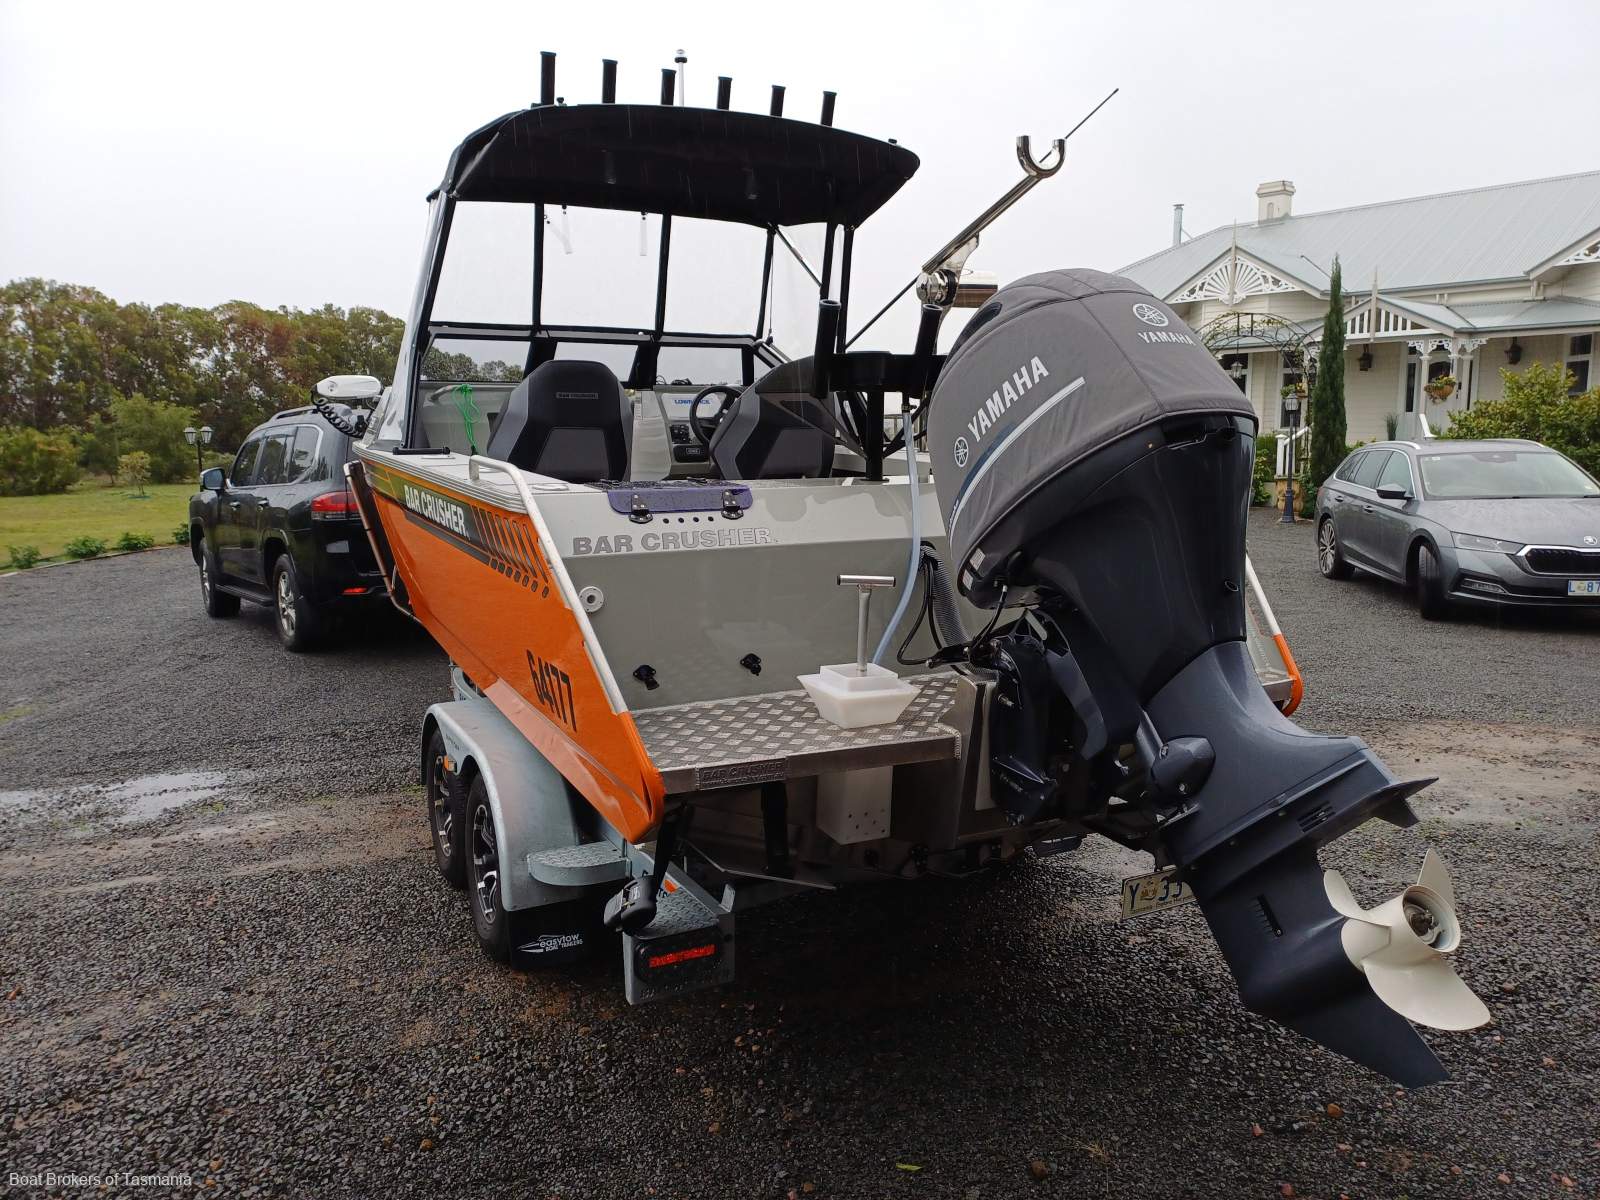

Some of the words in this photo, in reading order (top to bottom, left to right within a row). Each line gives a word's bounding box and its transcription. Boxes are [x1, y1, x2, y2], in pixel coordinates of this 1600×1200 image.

[1137, 331, 1197, 346] YAMAHA
[967, 355, 1049, 442] YAMAHA
[404, 484, 422, 515] BAR
[420, 491, 467, 537] CRUSHER
[572, 534, 633, 555] BAR
[641, 527, 770, 550] CRUSHER
[539, 933, 579, 947] easytow
